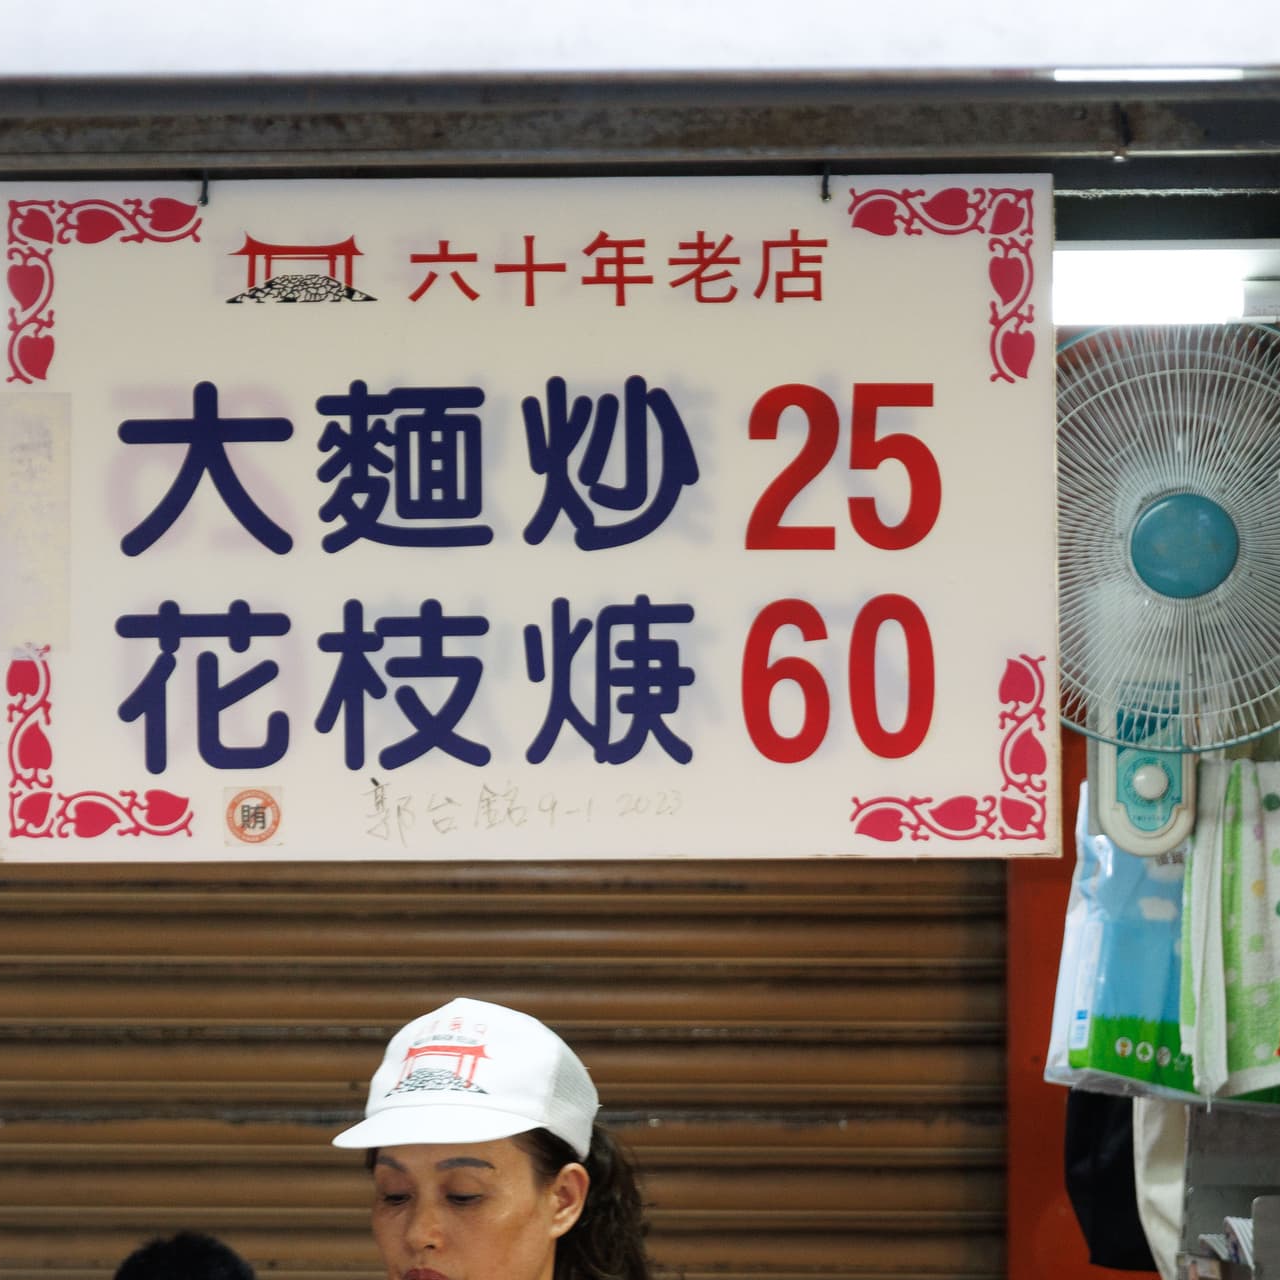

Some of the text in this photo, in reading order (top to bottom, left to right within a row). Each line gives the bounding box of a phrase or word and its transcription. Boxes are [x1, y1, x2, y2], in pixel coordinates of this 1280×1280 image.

[410, 229, 828, 307] 六十年老店
[120, 376, 943, 556] 大麵炒 25
[116, 593, 936, 774] 花枝焿 60
